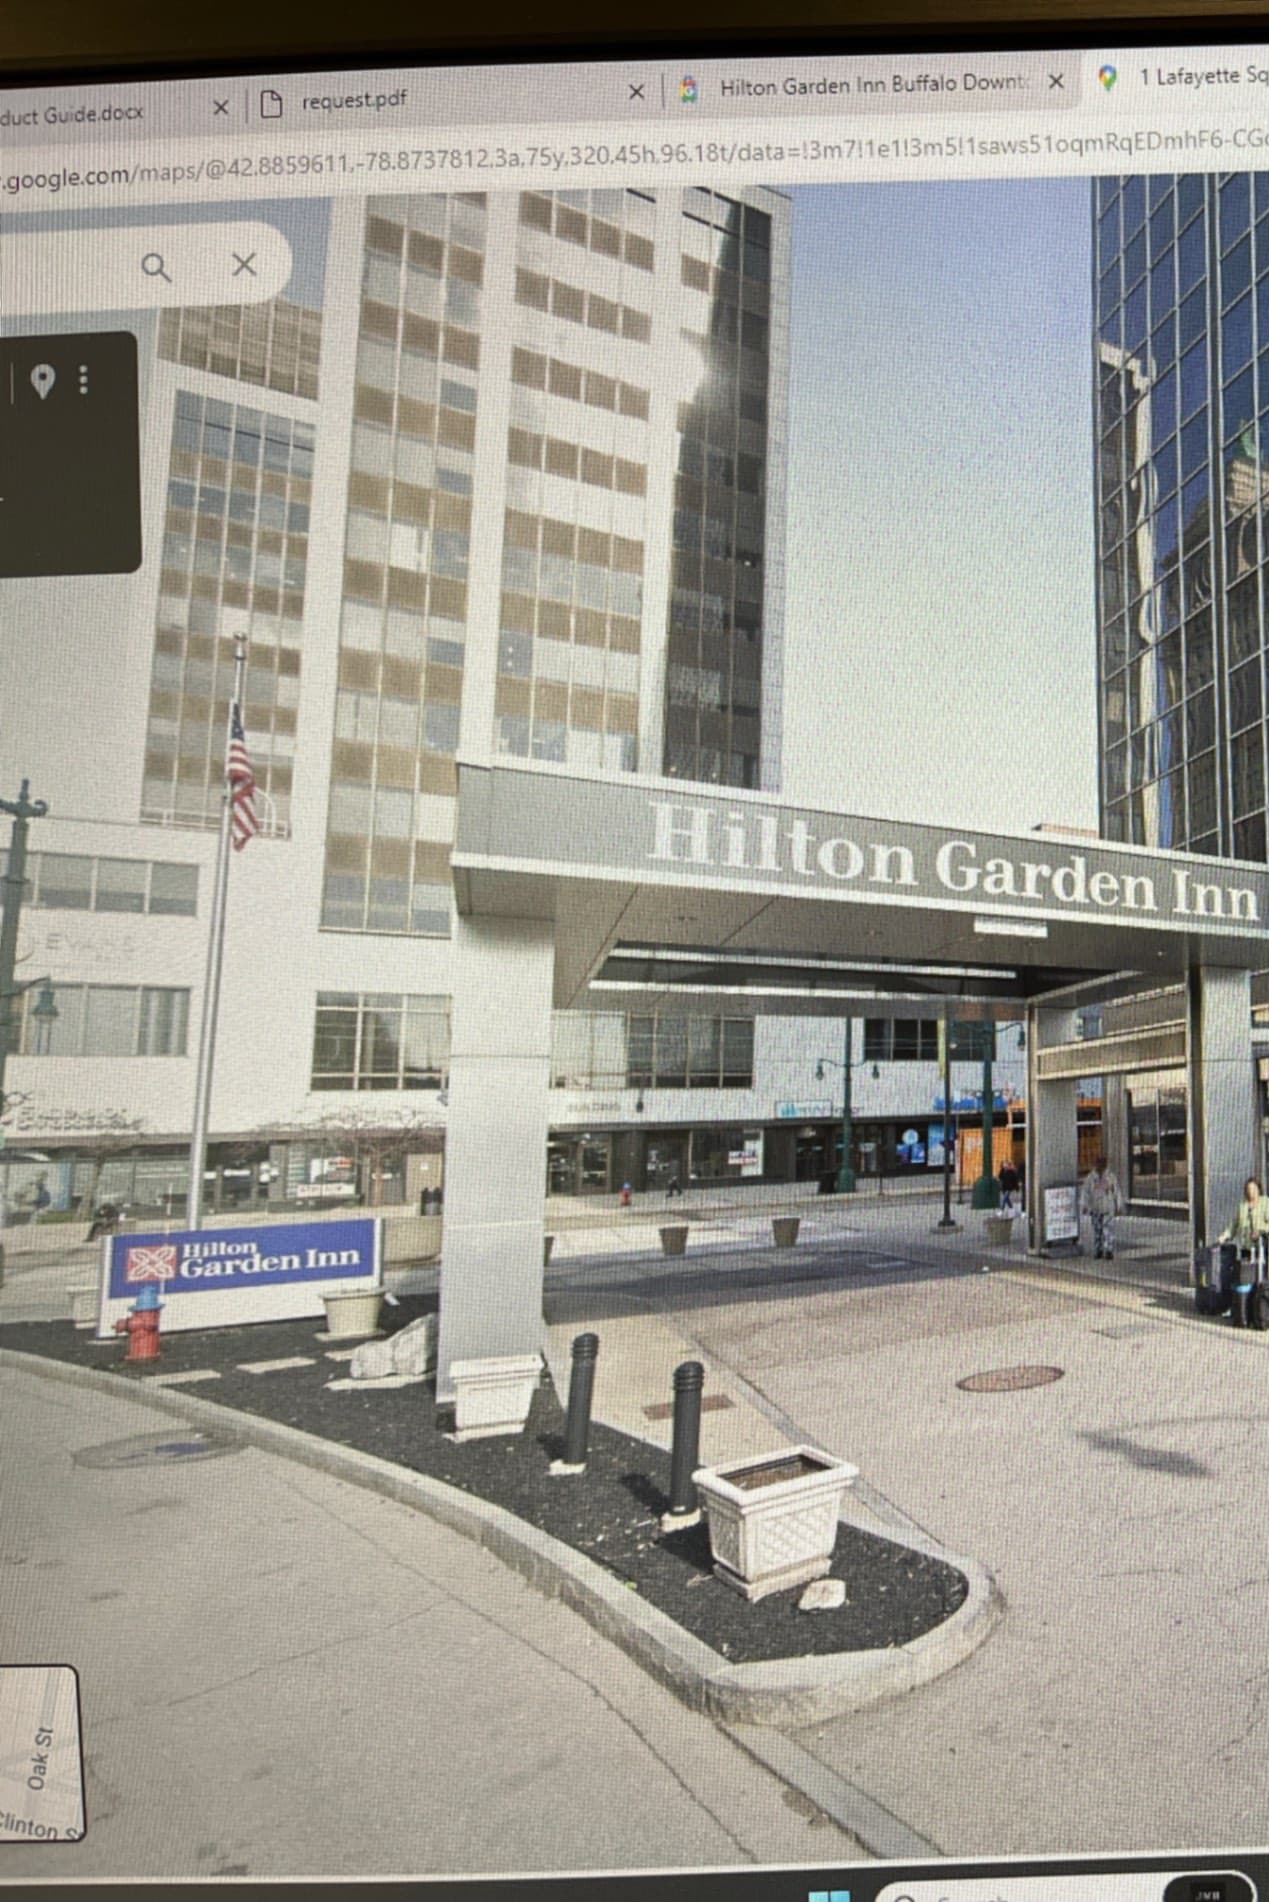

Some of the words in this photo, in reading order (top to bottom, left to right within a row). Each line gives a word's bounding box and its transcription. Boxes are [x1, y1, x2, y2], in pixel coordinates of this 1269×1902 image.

[721, 79, 777, 97] Hilton
[783, 77, 850, 96] Garden
[857, 76, 886, 93] Inn
[892, 74, 958, 93] Buffalo
[963, 72, 1029, 91] Downt
[1141, 68, 1149, 85] 1
[1157, 66, 1241, 88] Lafayette
[303, 88, 408, 113] request.pdf
[0, 109, 39, 127] duct
[44, 105, 144, 125] Guide.docx
[647, 800, 919, 886] Hilton
[935, 839, 1160, 914] Garden
[1171, 868, 1263, 923] Inn
[182, 1241, 258, 1258] Hilton
[180, 1251, 301, 1278] Garden
[305, 1248, 361, 1269] Inn
[35, 1727, 53, 1748] St
[27, 1751, 49, 1791] Oak
